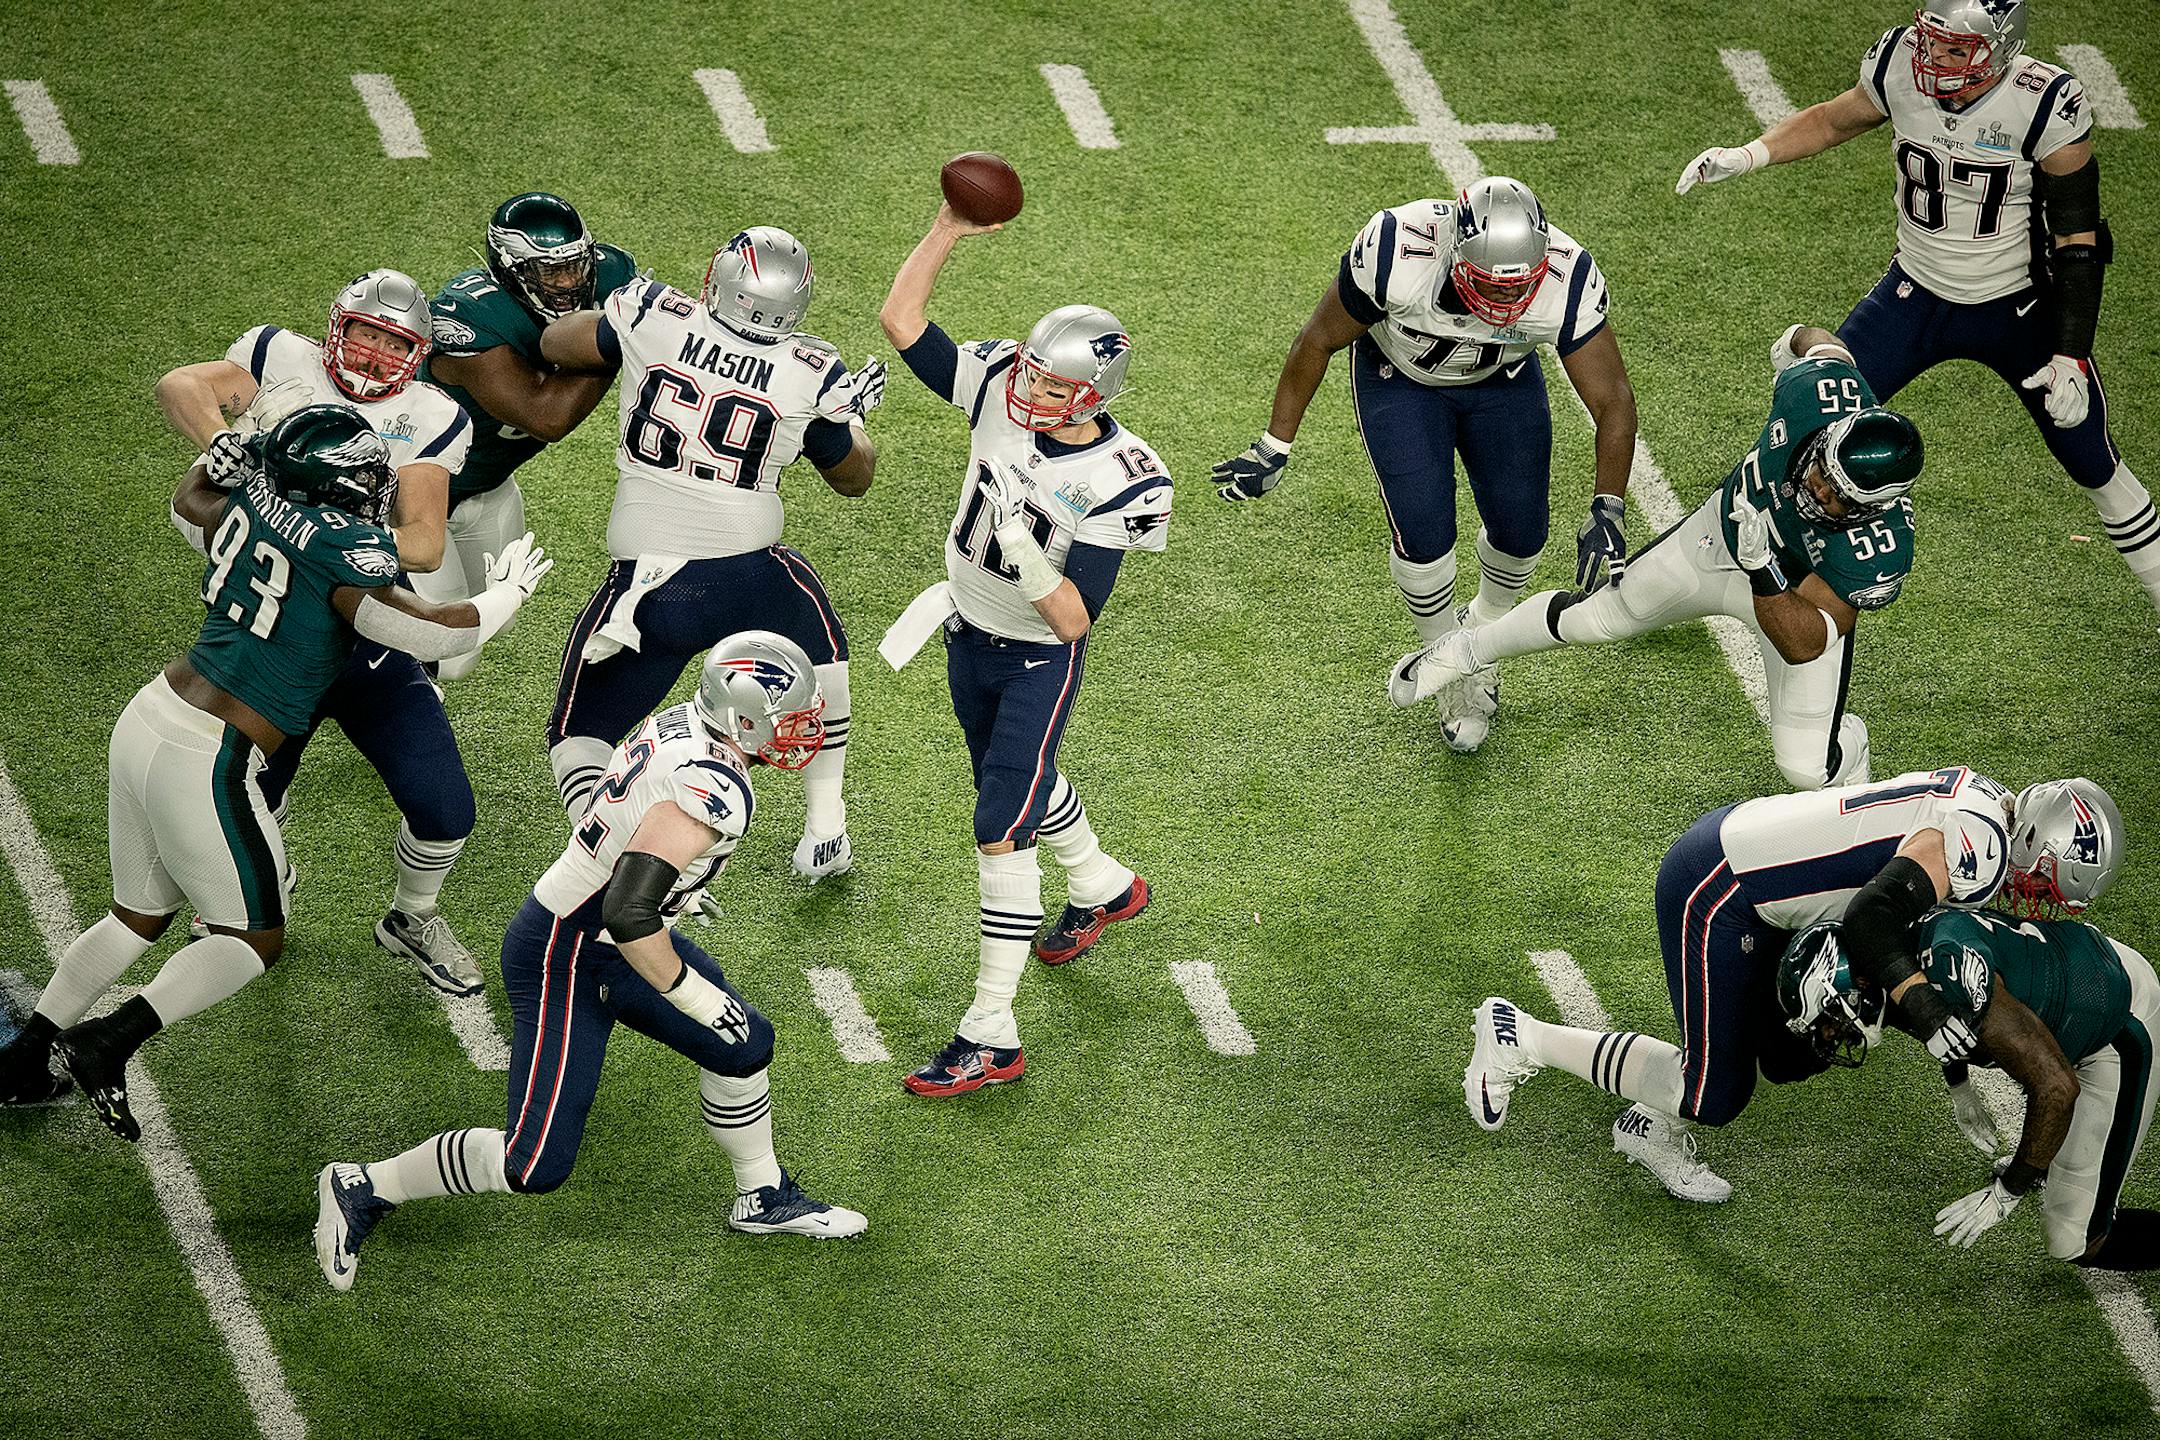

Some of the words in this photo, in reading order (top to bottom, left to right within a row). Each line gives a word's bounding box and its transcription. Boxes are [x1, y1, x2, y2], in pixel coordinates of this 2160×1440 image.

[1932, 135, 1965, 150] PATRIOTS
[1896, 138, 2015, 240] 87
[1400, 221, 1439, 260] 71
[451, 275, 499, 300] 91
[750, 310, 785, 329] 69
[677, 332, 775, 394] MASON
[1816, 378, 1861, 414] 55
[621, 363, 783, 493] 69
[1009, 463, 1038, 491] PATRIOTS
[1113, 446, 1160, 482] 12
[1846, 520, 1897, 561] 55
[199, 504, 290, 640] 93
[1492, 1002, 1519, 1047] NIKE
[1616, 1109, 1654, 1139] NIKE
